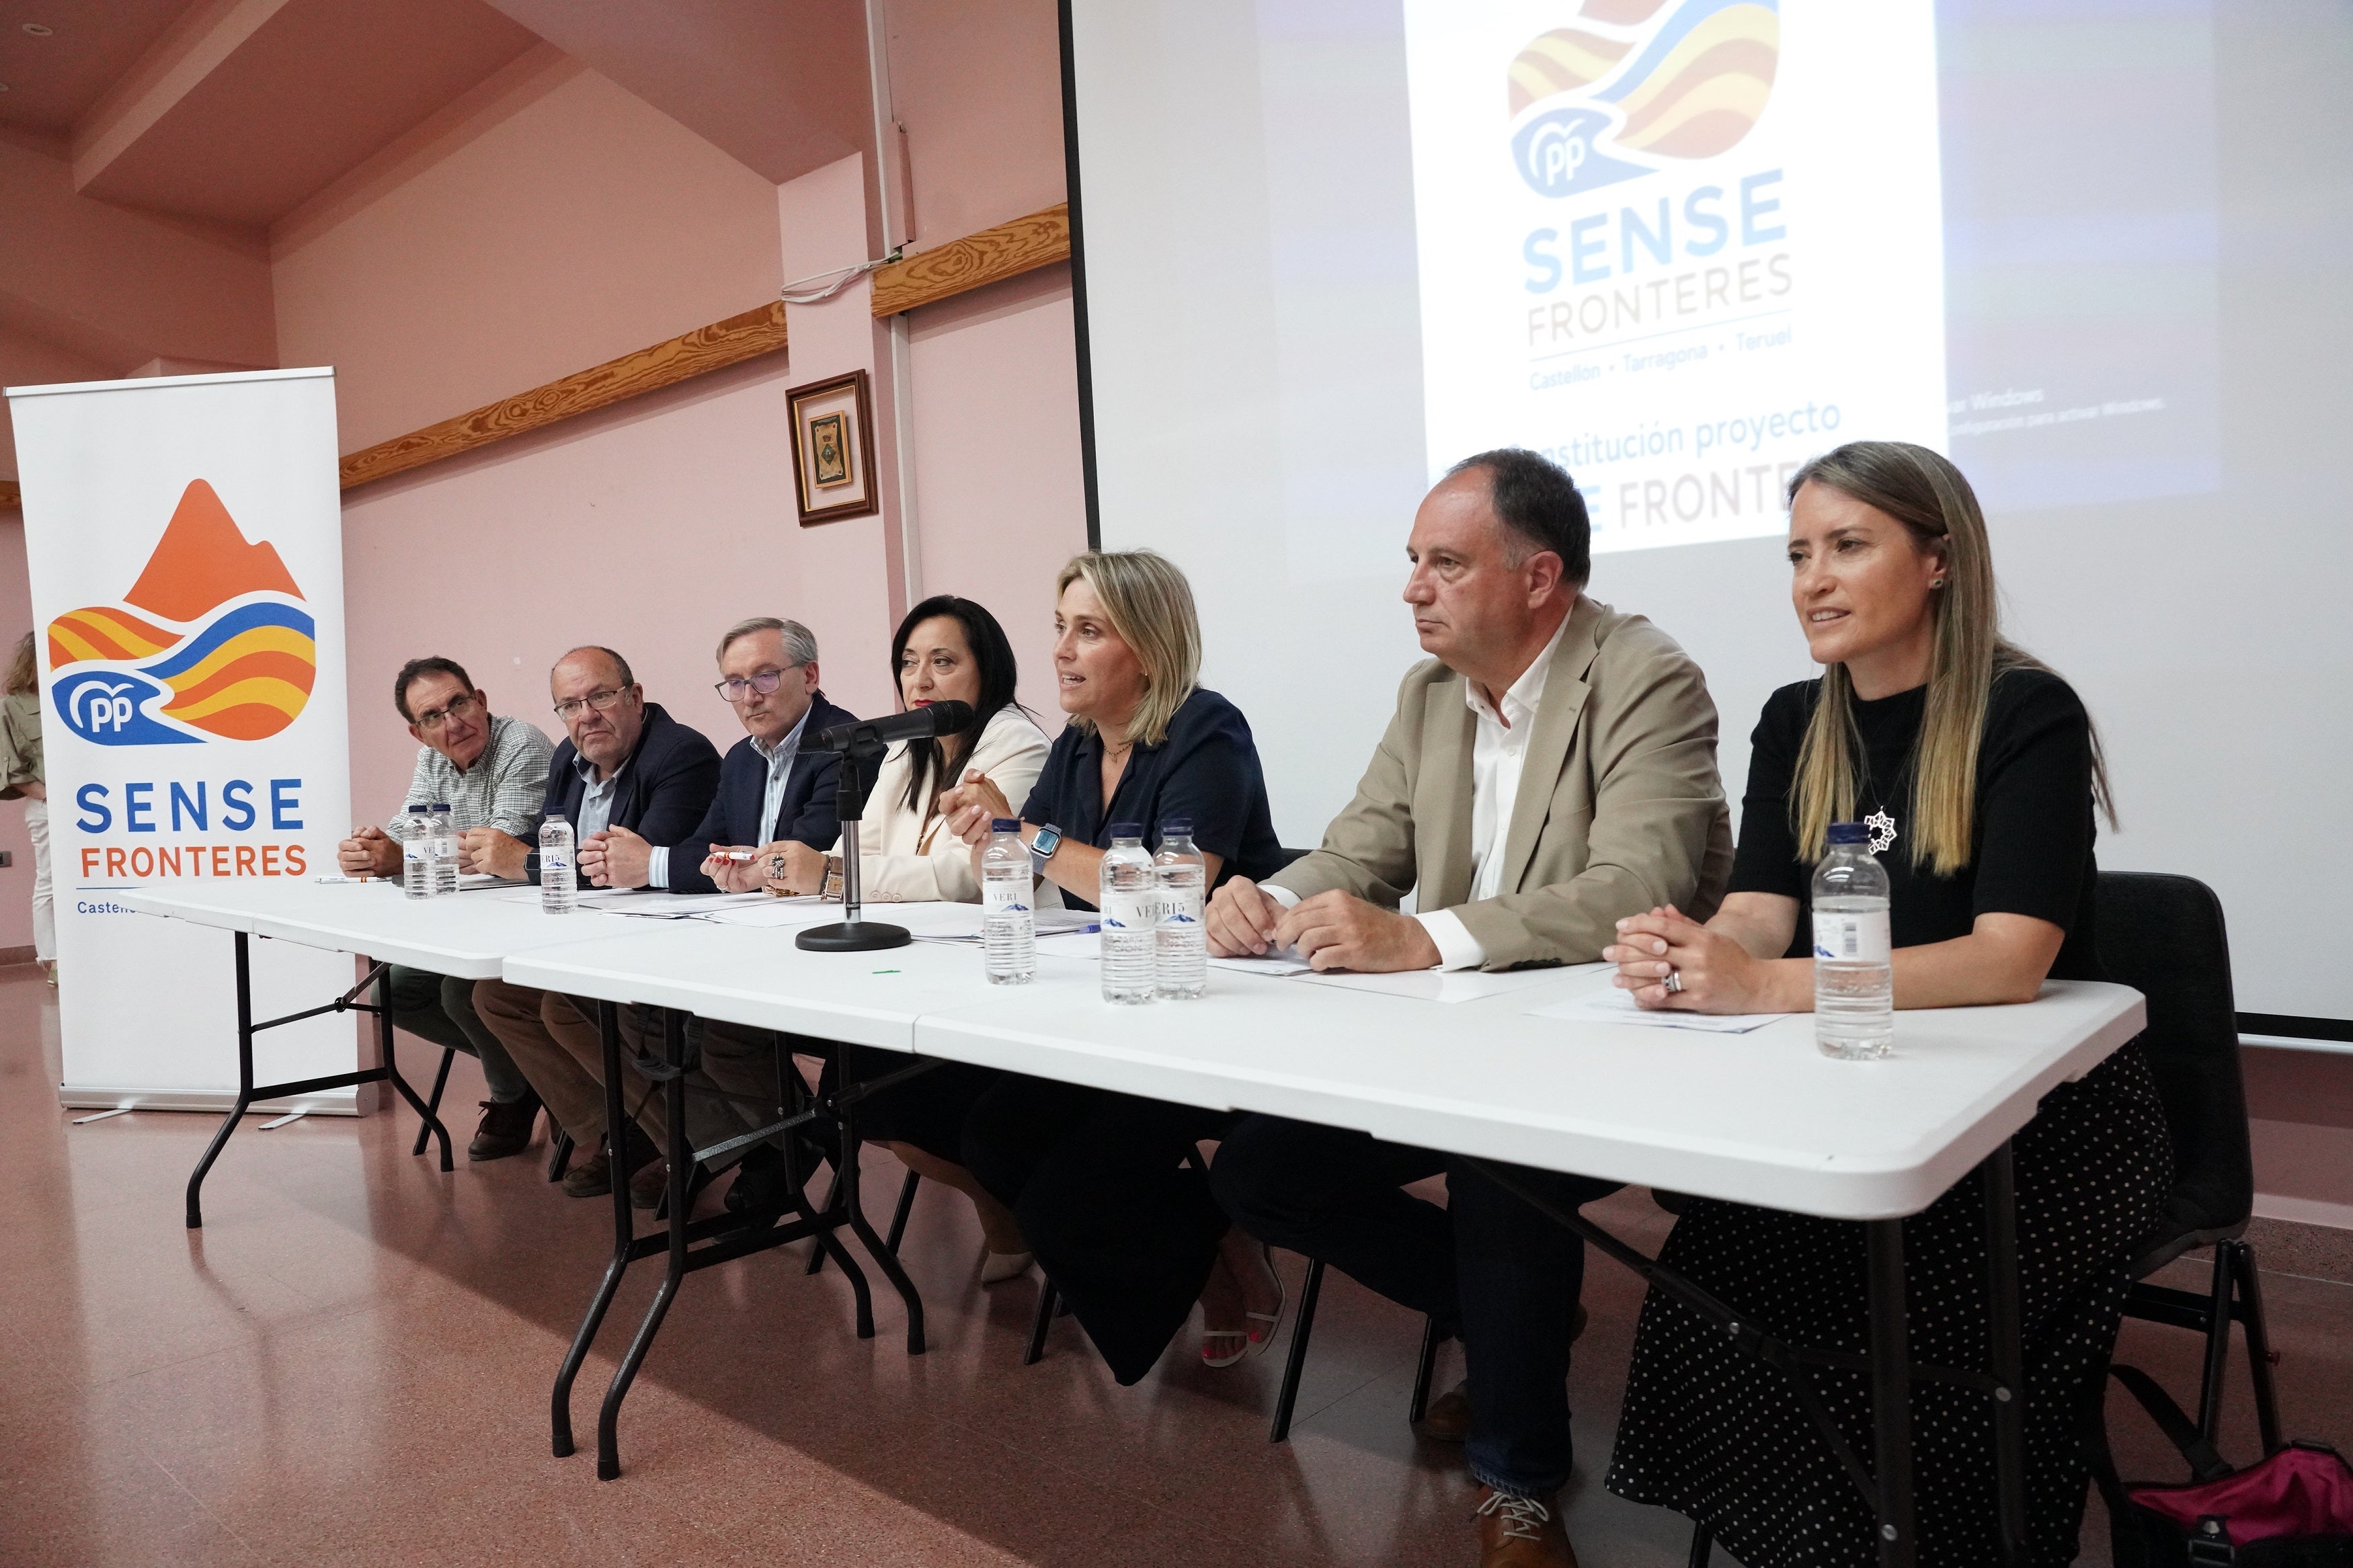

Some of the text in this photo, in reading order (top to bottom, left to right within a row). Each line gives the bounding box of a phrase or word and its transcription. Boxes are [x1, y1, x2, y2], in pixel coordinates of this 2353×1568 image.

[1523, 168, 1788, 294] SENSE
[1527, 253, 1793, 347] FRONTERES
[1529, 323, 1792, 391] Castellón Tarragona Teruel
[1509, 401, 1841, 468] nstitución proyecto
[1619, 460, 1800, 530] FRONTE
[90, 697, 133, 733] pp
[76, 778, 304, 834] SENSE
[81, 844, 307, 878] FRONTERES
[77, 901, 136, 913] Caste
